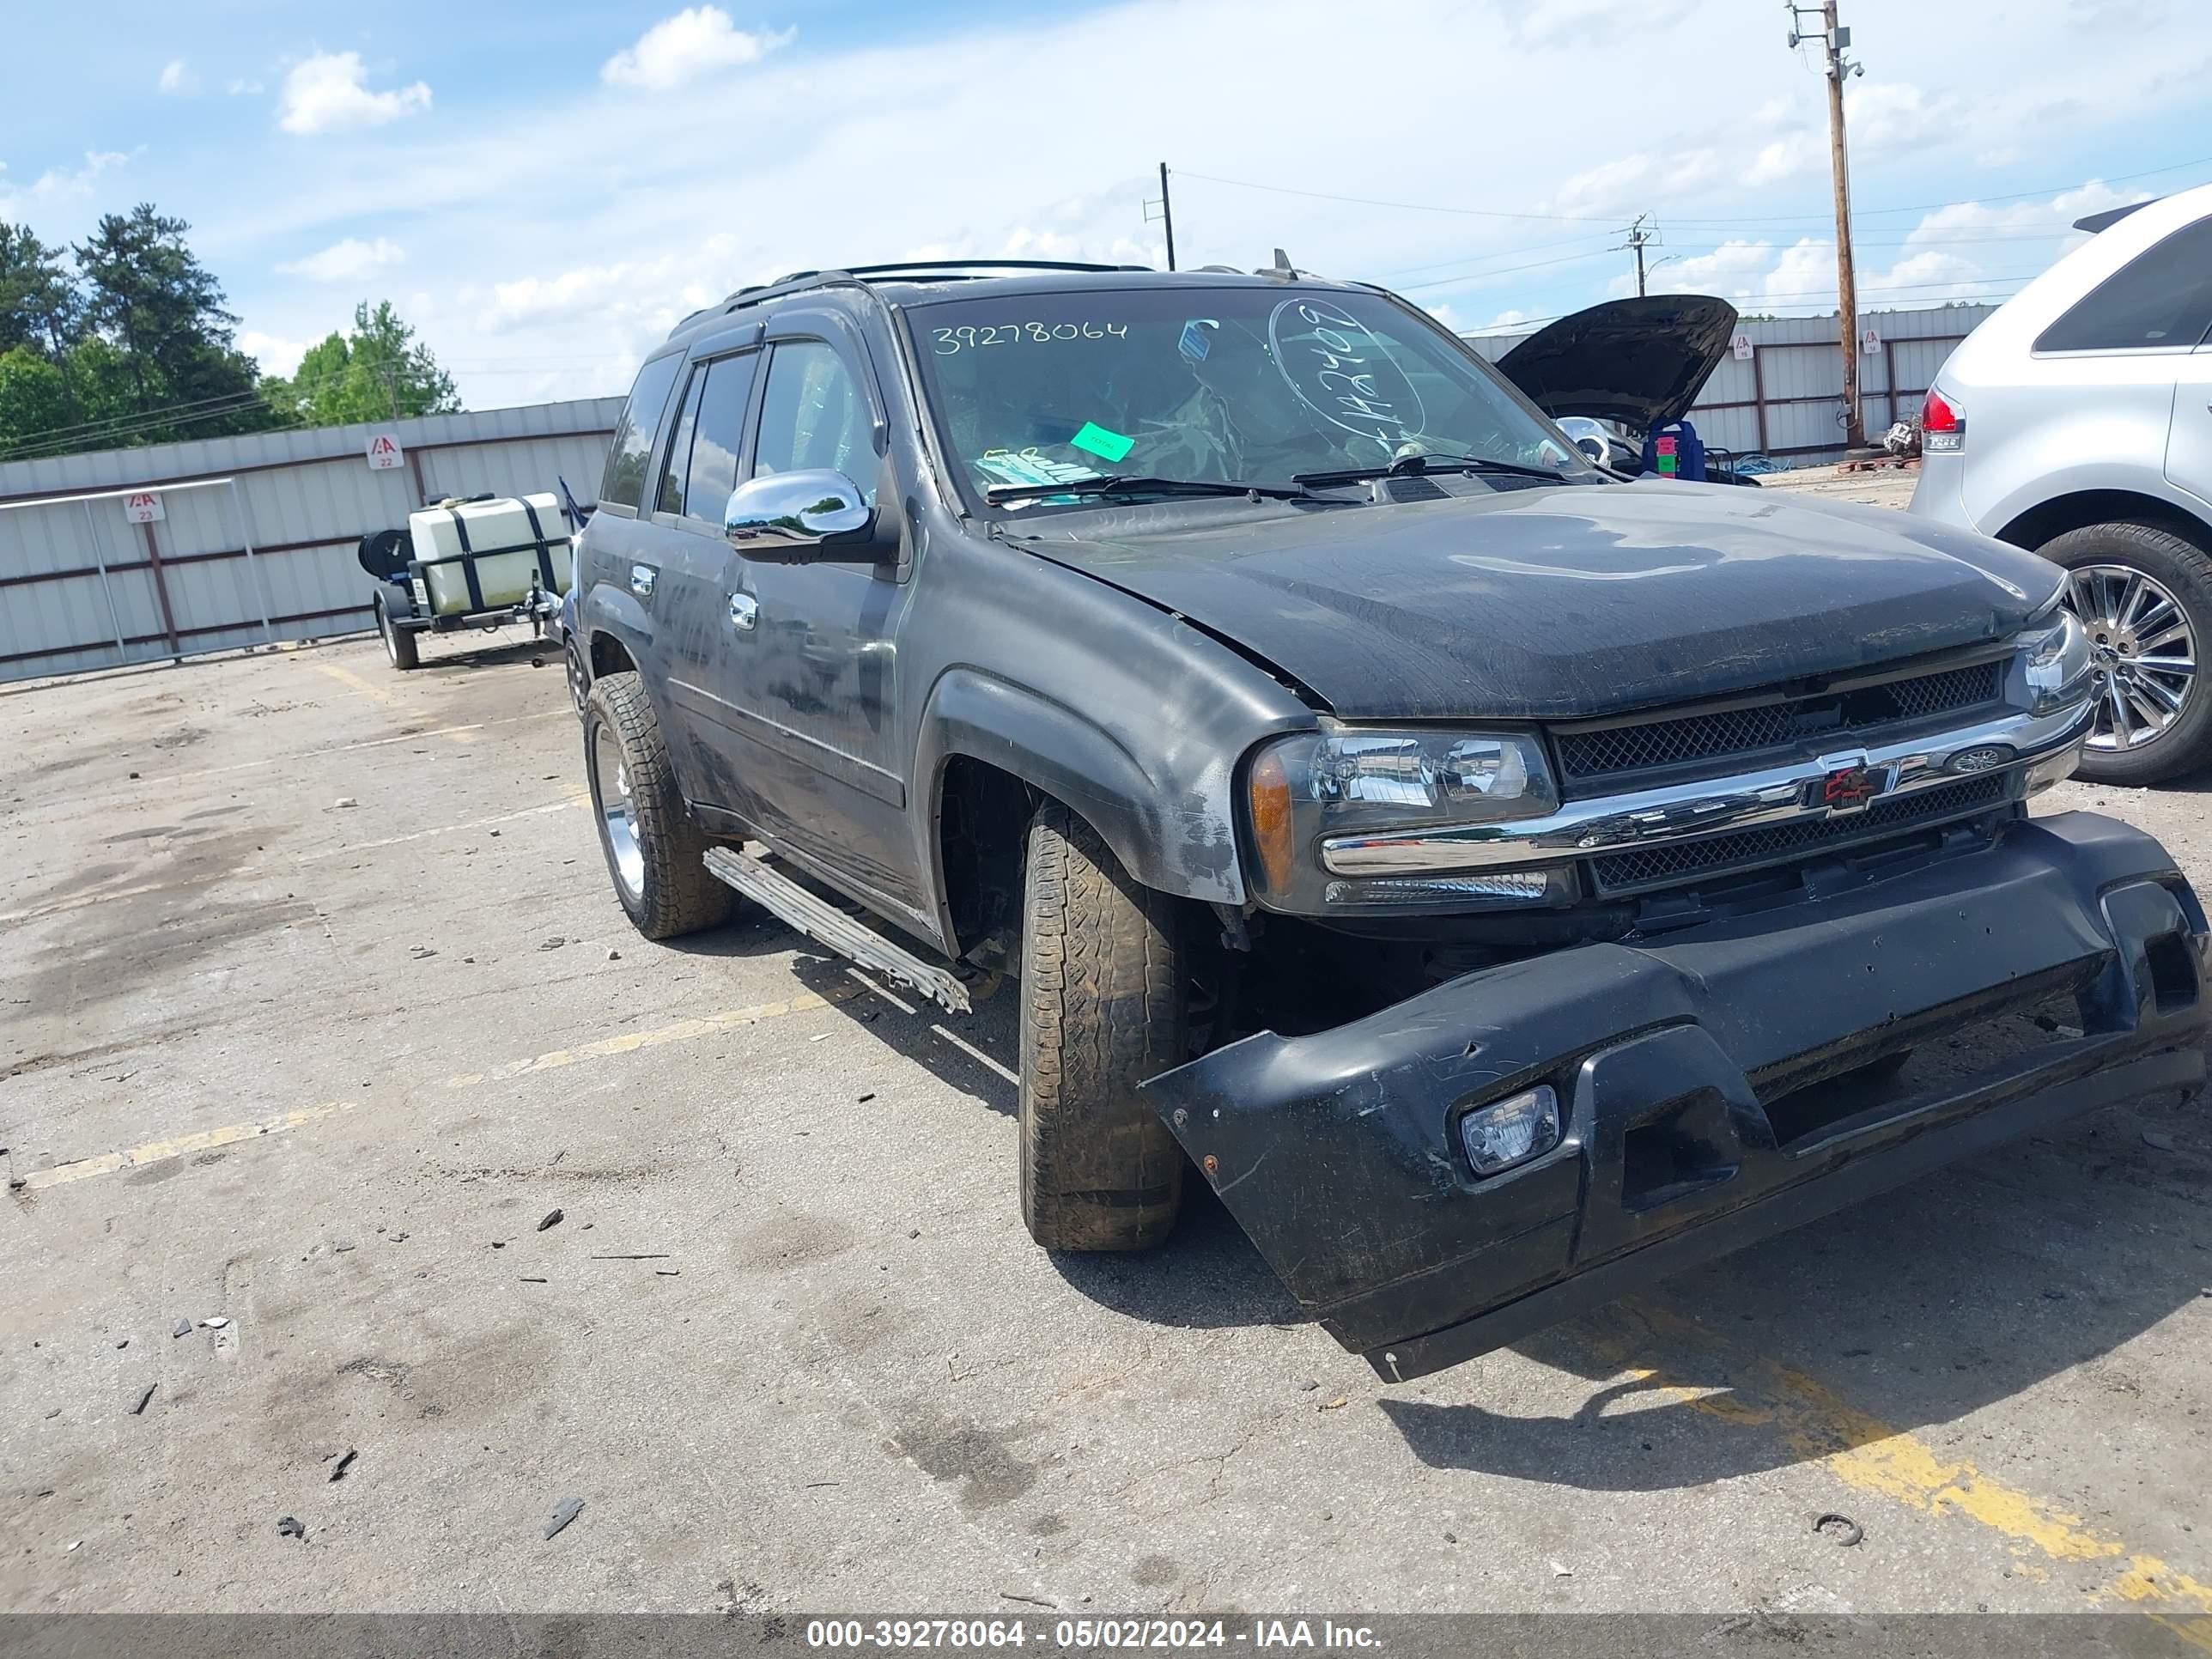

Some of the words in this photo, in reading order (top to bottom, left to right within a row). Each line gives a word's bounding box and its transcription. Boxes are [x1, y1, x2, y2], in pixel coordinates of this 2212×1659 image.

[933, 321, 1128, 356] 39278064
[1091, 435, 1115, 450] TOTAL
[380, 458, 392, 467] 22
[139, 511, 153, 520] 23
